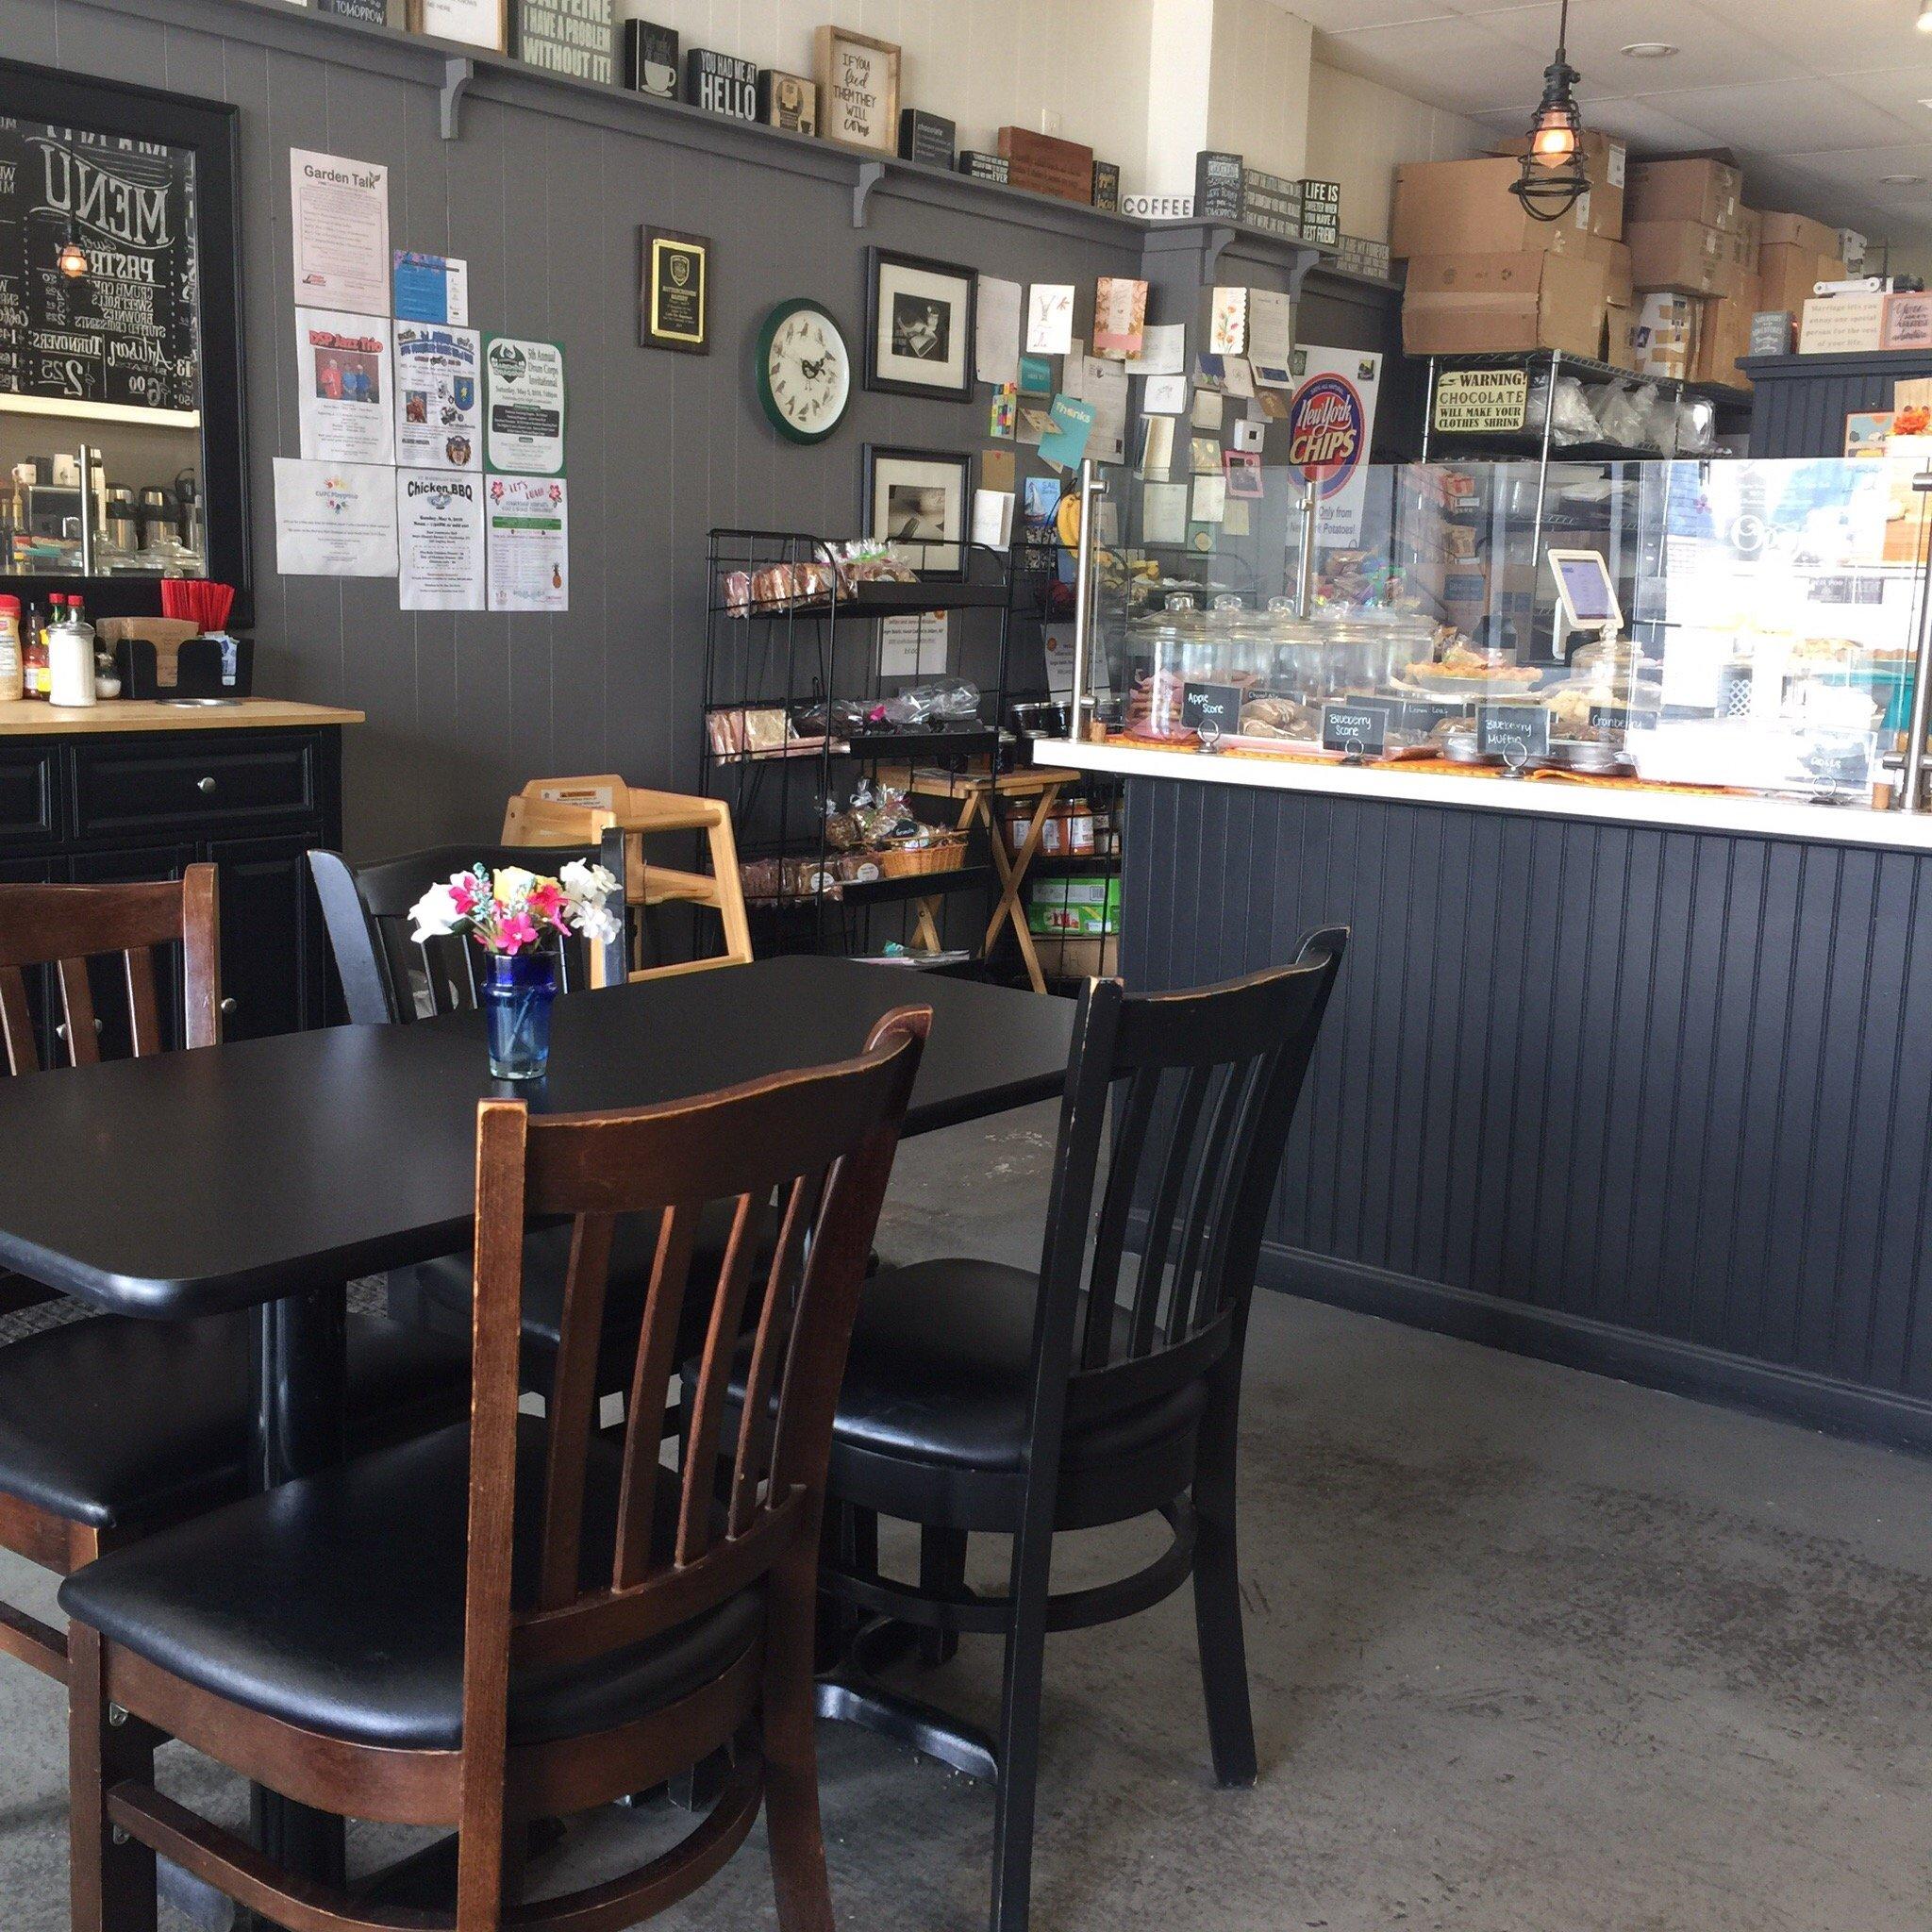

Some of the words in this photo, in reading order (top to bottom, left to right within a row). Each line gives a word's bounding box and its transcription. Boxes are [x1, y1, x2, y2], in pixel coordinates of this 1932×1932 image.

[524, 35, 591, 79] WITHOUT
[592, 54, 611, 85] IT!
[701, 50, 717, 74] YOU
[717, 55, 733, 77] HAD
[733, 59, 745, 79] ME
[745, 63, 757, 83] AT
[700, 72, 756, 122] HELLO
[846, 103, 868, 122] WILL
[304, 164, 349, 185] Garden
[351, 174, 375, 190] Talk
[1305, 181, 1325, 201] LIFE
[1327, 184, 1339, 202] IS
[1124, 196, 1191, 217] COFFEE
[1304, 211, 1316, 224] YOU
[1316, 213, 1331, 225] HAVE
[1331, 214, 1337, 226] A
[1811, 304, 1845, 313] Marriage
[1809, 317, 1832, 325] annoy
[1847, 314, 1877, 324] special
[1806, 328, 1831, 337] person
[358, 336, 383, 354] Trio
[1826, 340, 1844, 348] your
[1459, 373, 1527, 387] WARNING!
[1440, 391, 1524, 405] CHOCOLATE
[1057, 401, 1091, 424] Thanks
[1298, 399, 1321, 431] New
[1313, 394, 1353, 439] York
[1440, 408, 1462, 417] WILL
[1466, 407, 1491, 417] MAKE
[1495, 407, 1522, 416] YOUR
[1439, 418, 1480, 427] CLOTHES
[1483, 418, 1519, 427] SHRINK
[1289, 427, 1357, 466] CHIPS
[408, 480, 448, 498] Chicken
[451, 483, 474, 502] BBQ
[1319, 506, 1334, 520] Only
[1335, 507, 1352, 519] from
[1323, 523, 1357, 536] Potatoes!
[1188, 692, 1209, 705] Apple
[1485, 719, 1532, 736] Blueberry
